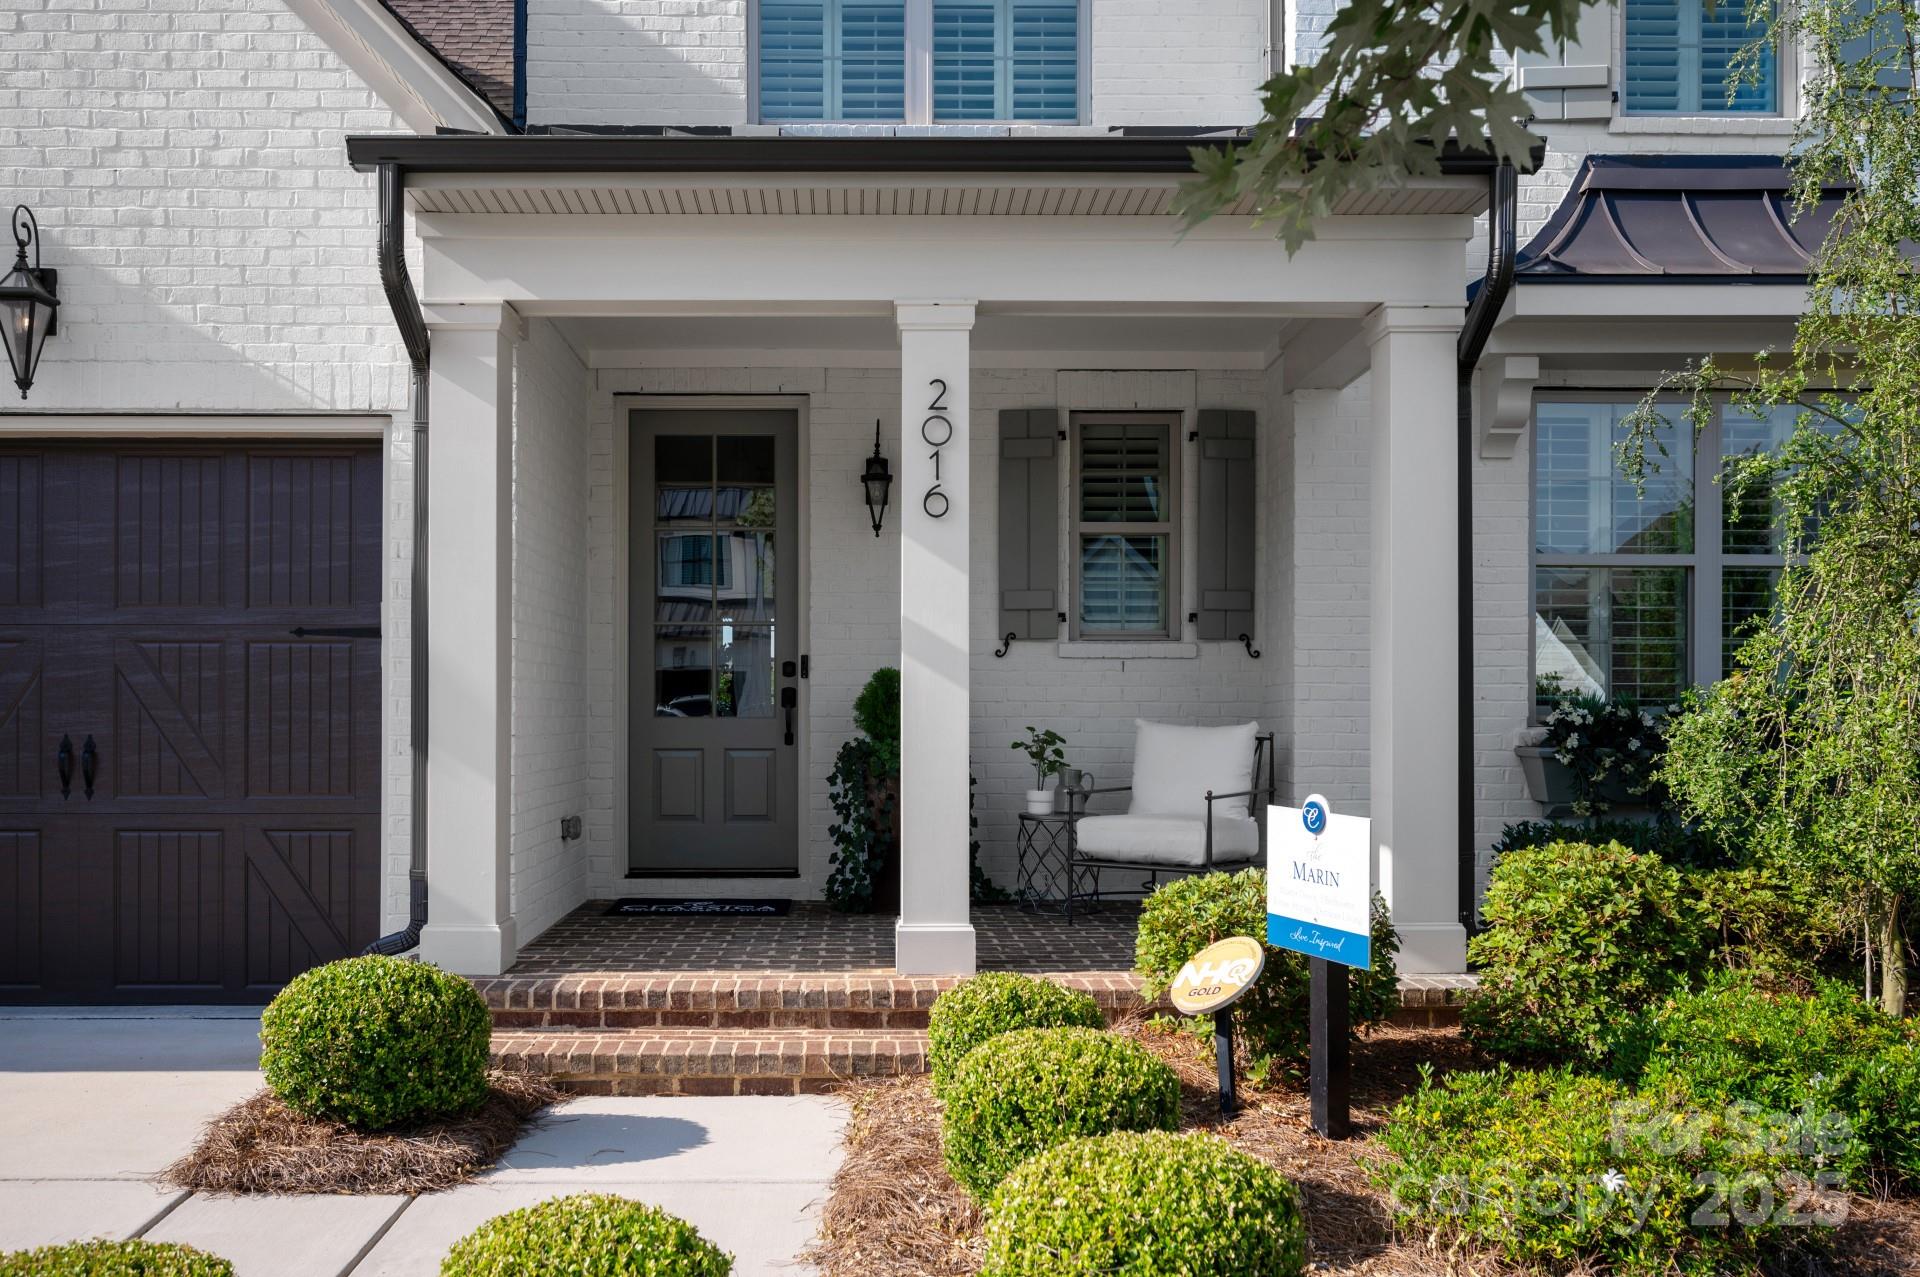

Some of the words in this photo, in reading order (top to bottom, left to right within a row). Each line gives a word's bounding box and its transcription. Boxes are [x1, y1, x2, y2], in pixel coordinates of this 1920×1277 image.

[921, 378, 953, 518] 2016
[1293, 861, 1340, 888] MARIN
[1188, 987, 1221, 996] GOLD
